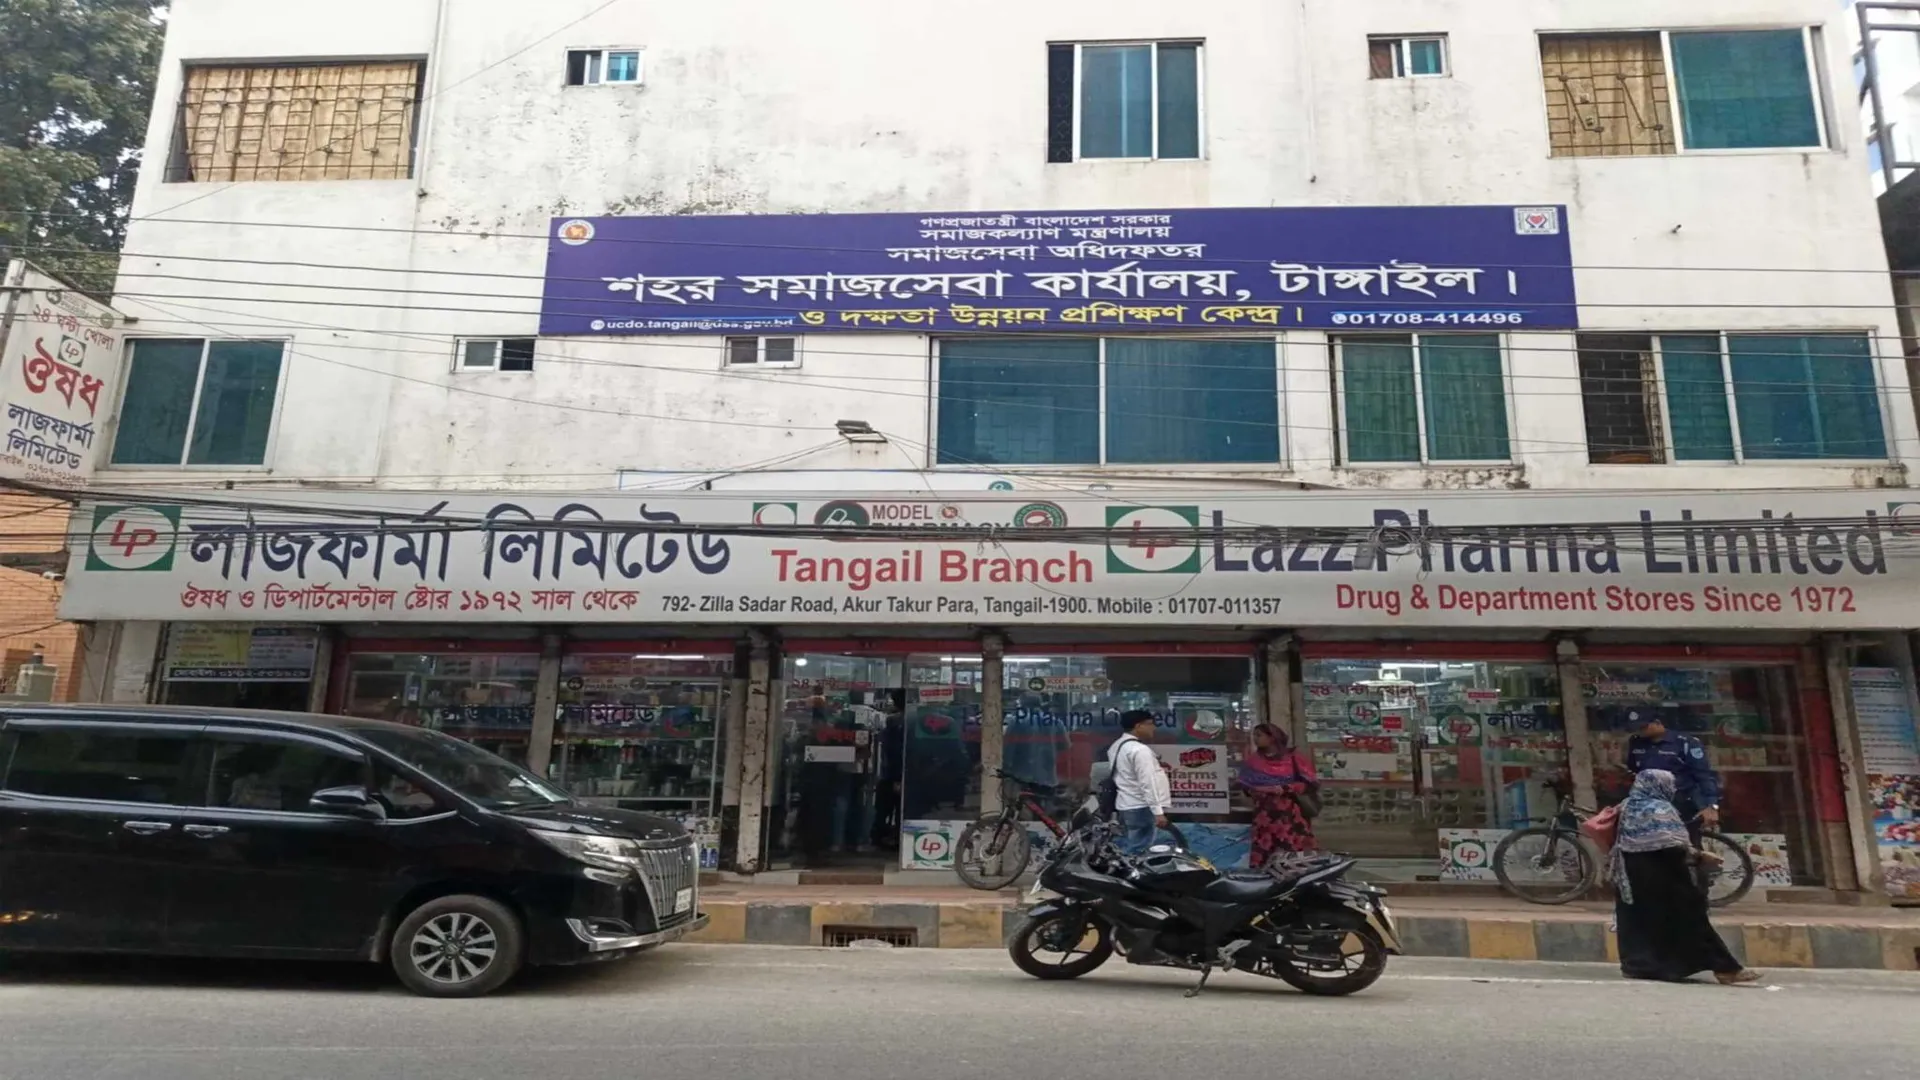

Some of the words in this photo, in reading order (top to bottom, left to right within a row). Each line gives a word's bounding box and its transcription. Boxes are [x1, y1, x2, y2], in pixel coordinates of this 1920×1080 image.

[918, 227, 1062, 241] সমাজকল্যাণ
[1070, 225, 1173, 239] মন্ত্রণালয়
[920, 214, 1017, 227] গণপ্রজাতন্ত্রী
[1024, 215, 1105, 227] বাংলাদেশ
[1110, 214, 1172, 225] সরকার
[885, 244, 1039, 262] সমাজসেবা
[1047, 240, 1206, 259] অধিদফতর
[602, 272, 725, 304] শহর
[736, 269, 1013, 301] সমাজসেবা
[1024, 261, 1251, 301] কার্যালয়,
[1269, 259, 1486, 299] টাঙ্গাইল
[799, 309, 825, 326] ও
[840, 306, 940, 326] দক্ষতা
[949, 303, 1051, 328] উন্নয়ন
[1058, 301, 1190, 324] প্রশিক্ষণ
[1200, 304, 1284, 325] কেন্দ্র
[1350, 312, 1522, 324] 01708-414496
[84, 328, 115, 351] খোলা
[22, 336, 104, 419] ঔষধ
[7, 402, 96, 450] লাজফার্মা
[6, 429, 83, 471] লিমিটেড
[872, 504, 933, 520] MODEL
[109, 519, 157, 557] LP
[187, 500, 450, 581] লাজফার্মা
[482, 502, 732, 582] লিমিটেড
[1212, 510, 1354, 573] Lazz
[1373, 509, 1620, 574] Pharma
[1640, 509, 1888, 575] Limited
[771, 549, 922, 591] Tangail
[939, 549, 1093, 583] Branch
[180, 582, 232, 609] ঔষধ
[239, 587, 254, 609] ও
[264, 581, 397, 610] ডিপার্টমেন্টাল
[460, 589, 523, 613] ১৯৭২
[531, 589, 575, 611] সাল
[583, 590, 640, 611] থেকে
[700, 595, 734, 612] Zilla
[738, 595, 787, 612] Sadar
[791, 596, 838, 615] Road,
[842, 596, 882, 613] Akur
[886, 597, 932, 613] Takur
[937, 597, 979, 616] Para,
[983, 596, 1092, 617] Tangail-1900.
[1097, 597, 1153, 614] Mobile
[1168, 598, 1282, 615] 01707-011357
[1336, 583, 1401, 616] Drug
[1412, 584, 1433, 610] &
[1438, 584, 1597, 618] Department
[1604, 585, 1695, 612] Stores
[1704, 586, 1781, 612] Since
[1790, 586, 1857, 612] 1972
[1016, 707, 1093, 728] Pharma
[922, 838, 941, 855] LP
[1459, 847, 1479, 863] LP
